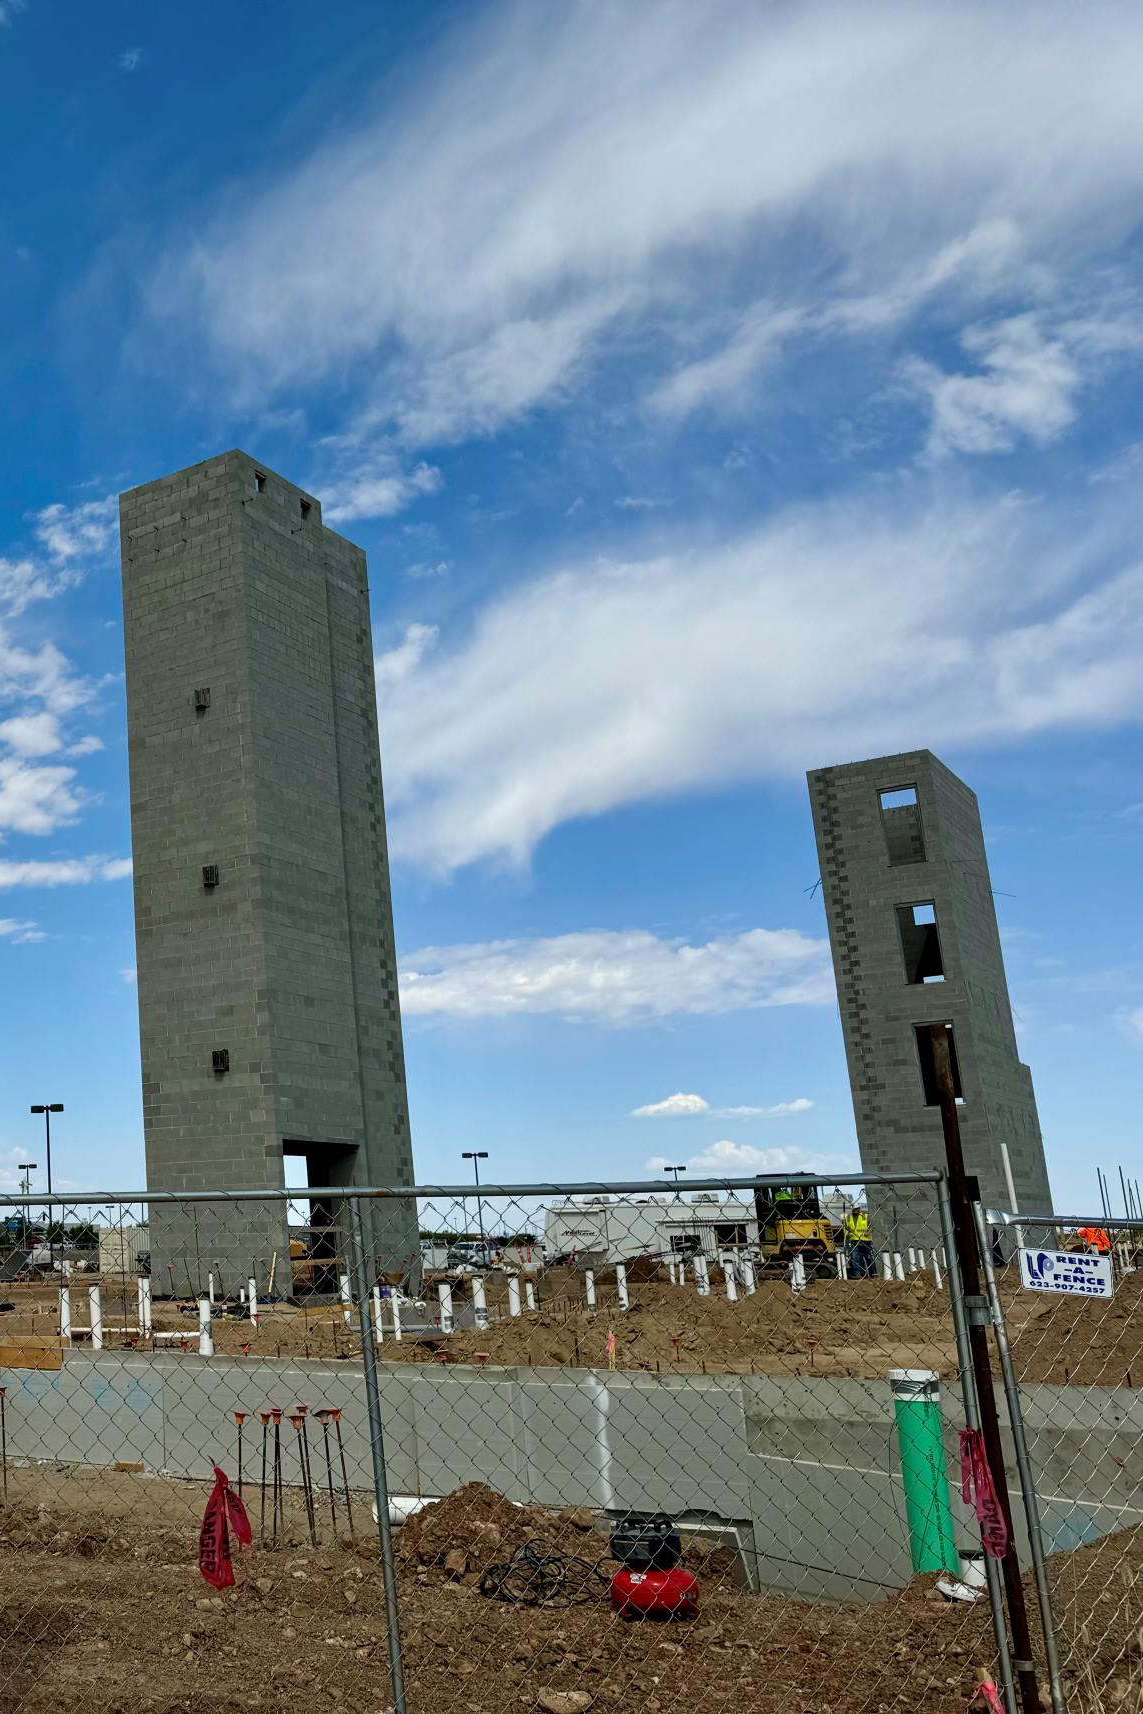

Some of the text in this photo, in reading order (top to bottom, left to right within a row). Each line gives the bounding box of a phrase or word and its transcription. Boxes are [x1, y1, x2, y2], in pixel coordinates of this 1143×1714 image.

[1056, 1255, 1099, 1267] RENT
[1053, 1274, 1105, 1286] FENCE
[1029, 1280, 1106, 1294] 623-907-4257
[200, 1501, 217, 1575] ANGER
